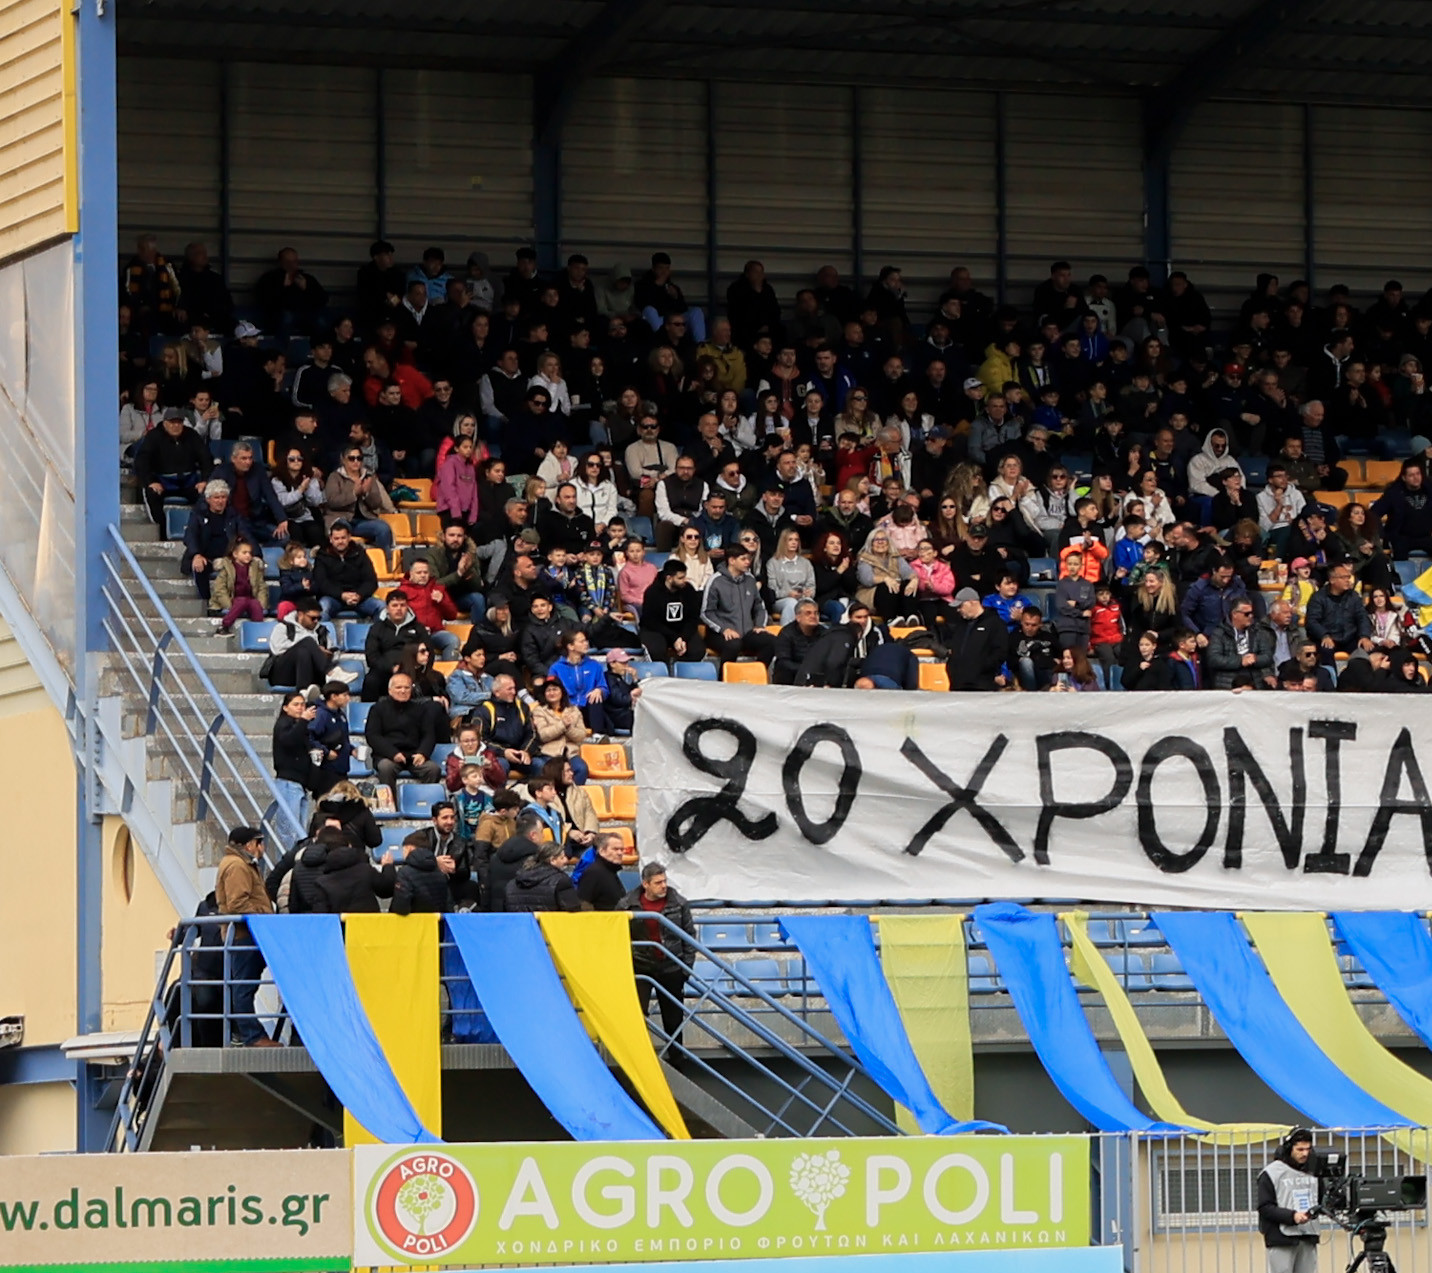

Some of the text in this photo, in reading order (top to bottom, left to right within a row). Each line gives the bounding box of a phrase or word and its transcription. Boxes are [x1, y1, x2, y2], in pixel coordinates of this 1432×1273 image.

[666, 715, 862, 854] 20
[400, 1157, 455, 1180] AGRO
[498, 1152, 1063, 1231] AGRO POLI
[403, 1234, 448, 1254] POLI
[497, 1230, 1067, 1255] ΧΟΝΔΡΙΚΟ ΕΜΠΟΡΙΟ ΦΡΟΥΤΩΝ ΚΑΙ ΛΑΧΑΝΙΚΩΝ
